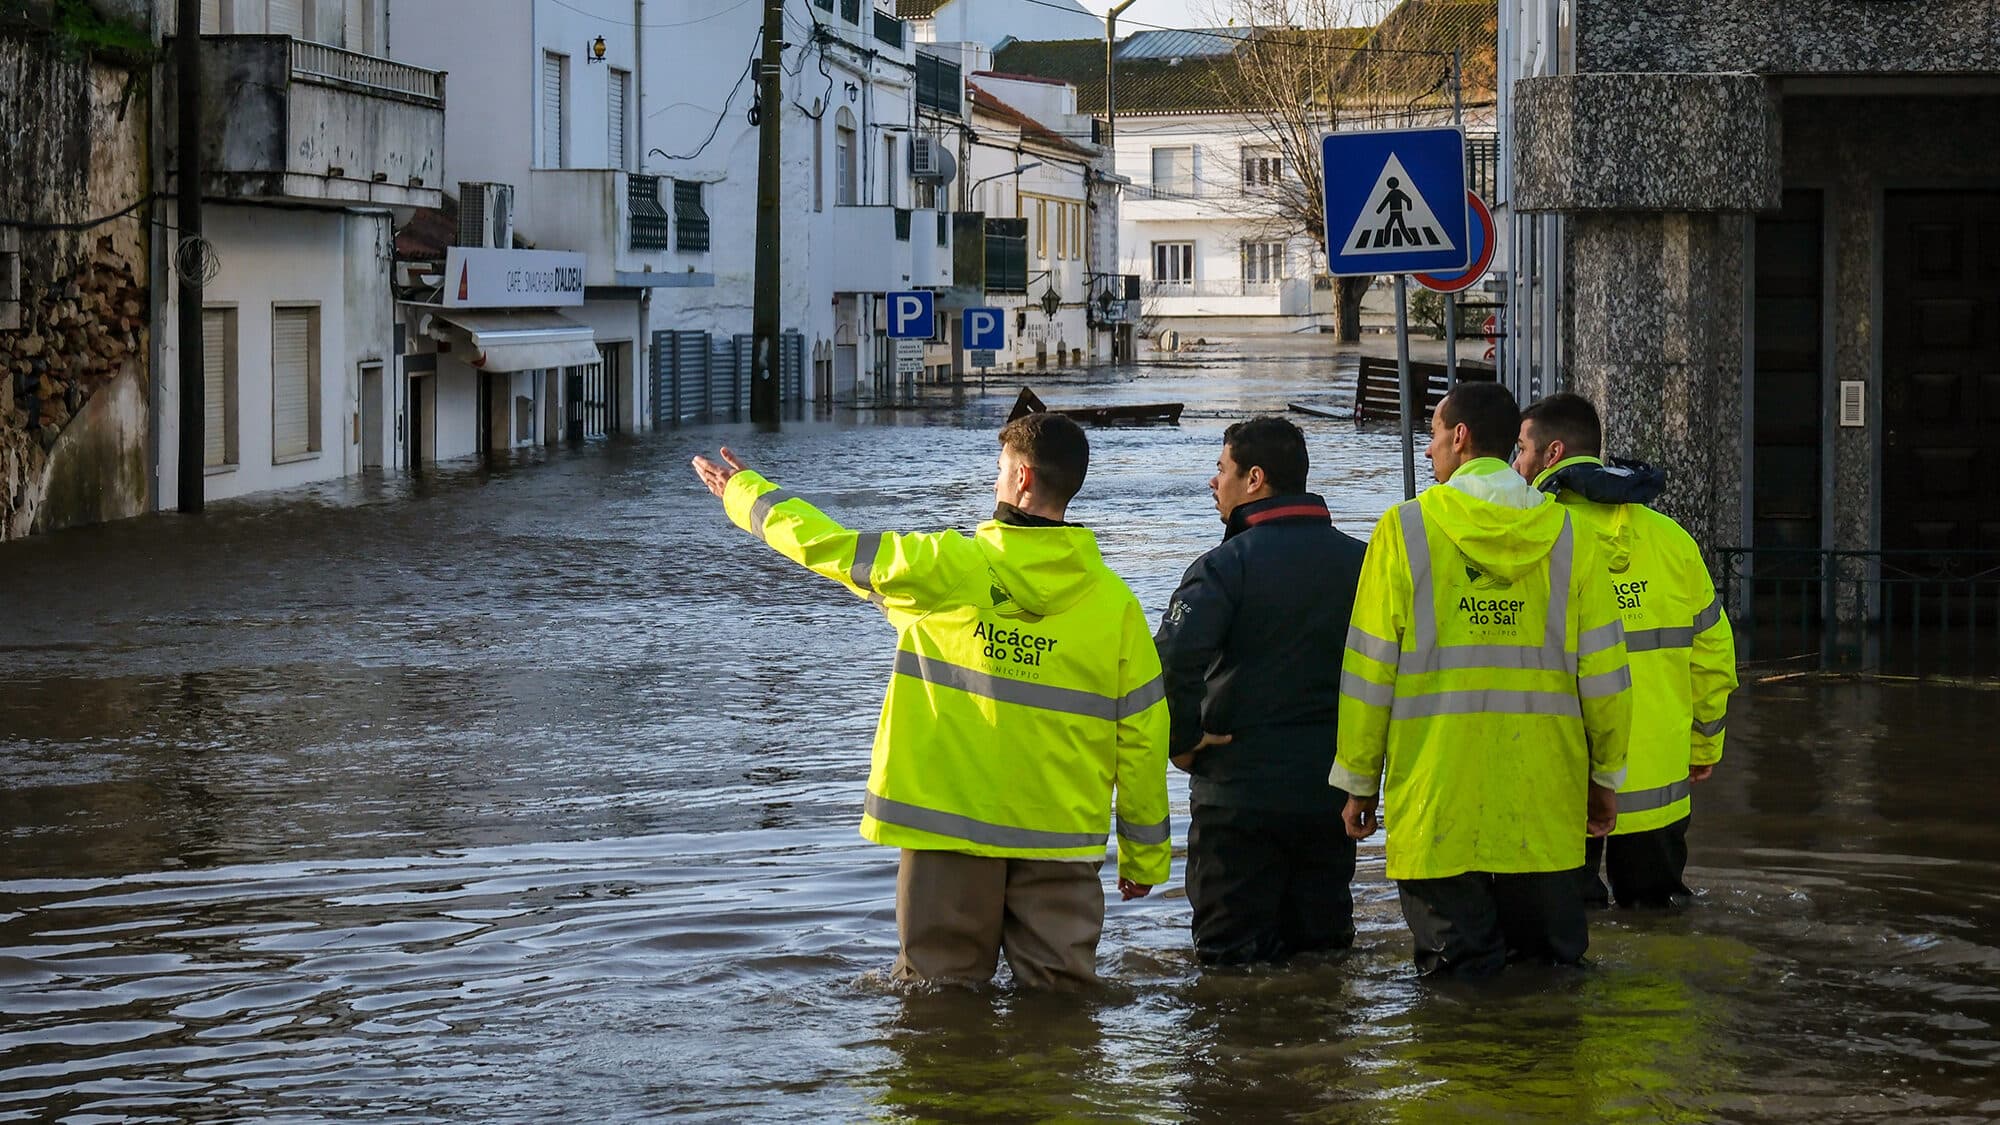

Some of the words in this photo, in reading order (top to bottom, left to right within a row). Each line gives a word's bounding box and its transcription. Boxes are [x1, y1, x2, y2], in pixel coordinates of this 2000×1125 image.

[897, 296, 923, 334] P
[972, 312, 995, 345] P
[1484, 325, 1496, 334] ST
[1617, 594, 1641, 609] Sal
[1469, 612, 1489, 625] do
[1493, 612, 1516, 625] Sal
[973, 621, 1057, 652] Alcácer
[984, 643, 1007, 660] do
[1012, 647, 1040, 666] Sal
